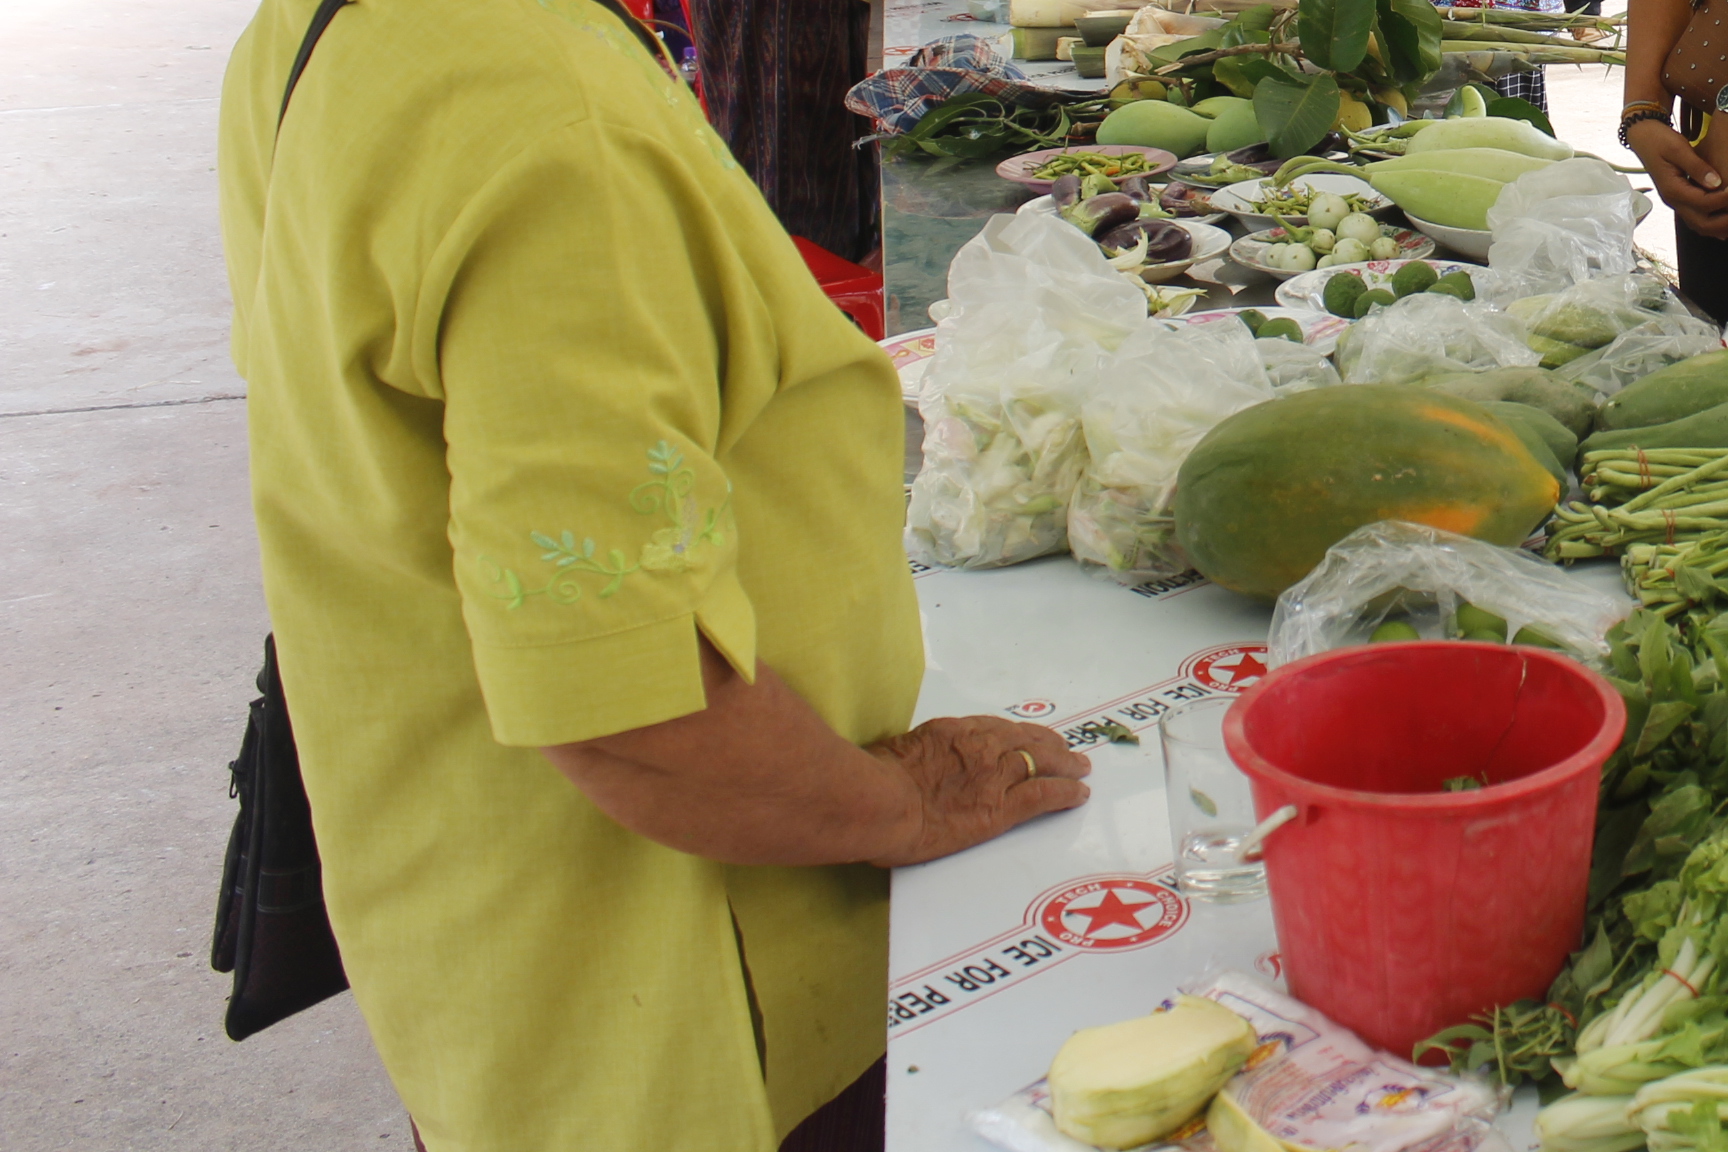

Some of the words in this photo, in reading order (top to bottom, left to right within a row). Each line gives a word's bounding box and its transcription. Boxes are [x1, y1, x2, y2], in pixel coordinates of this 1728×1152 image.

[1118, 698, 1170, 721] FOR
[1055, 883, 1101, 904] TECH
[1155, 890, 1179, 928] CHOICE
[1001, 935, 1063, 967] ICE
[1059, 931, 1096, 947] PRO
[944, 958, 1011, 992] FOR
